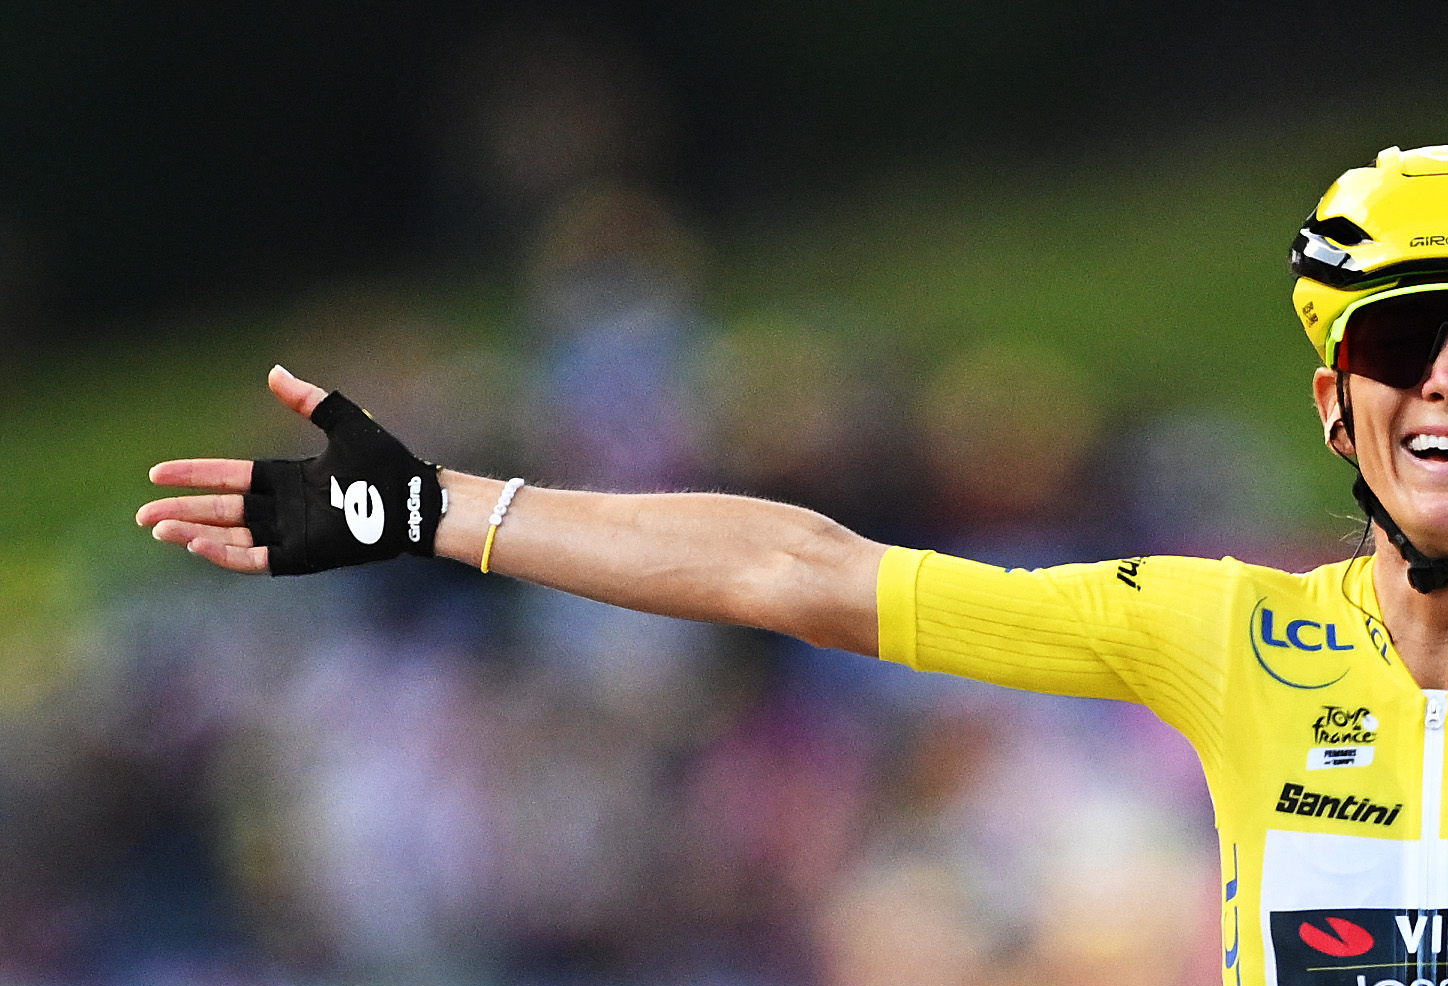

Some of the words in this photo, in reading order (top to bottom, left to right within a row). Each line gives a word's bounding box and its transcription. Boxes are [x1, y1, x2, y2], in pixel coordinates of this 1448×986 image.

[407, 476, 422, 542] GripGrab
[1261, 608, 1355, 651] LCL
[1275, 783, 1403, 826] Santini
